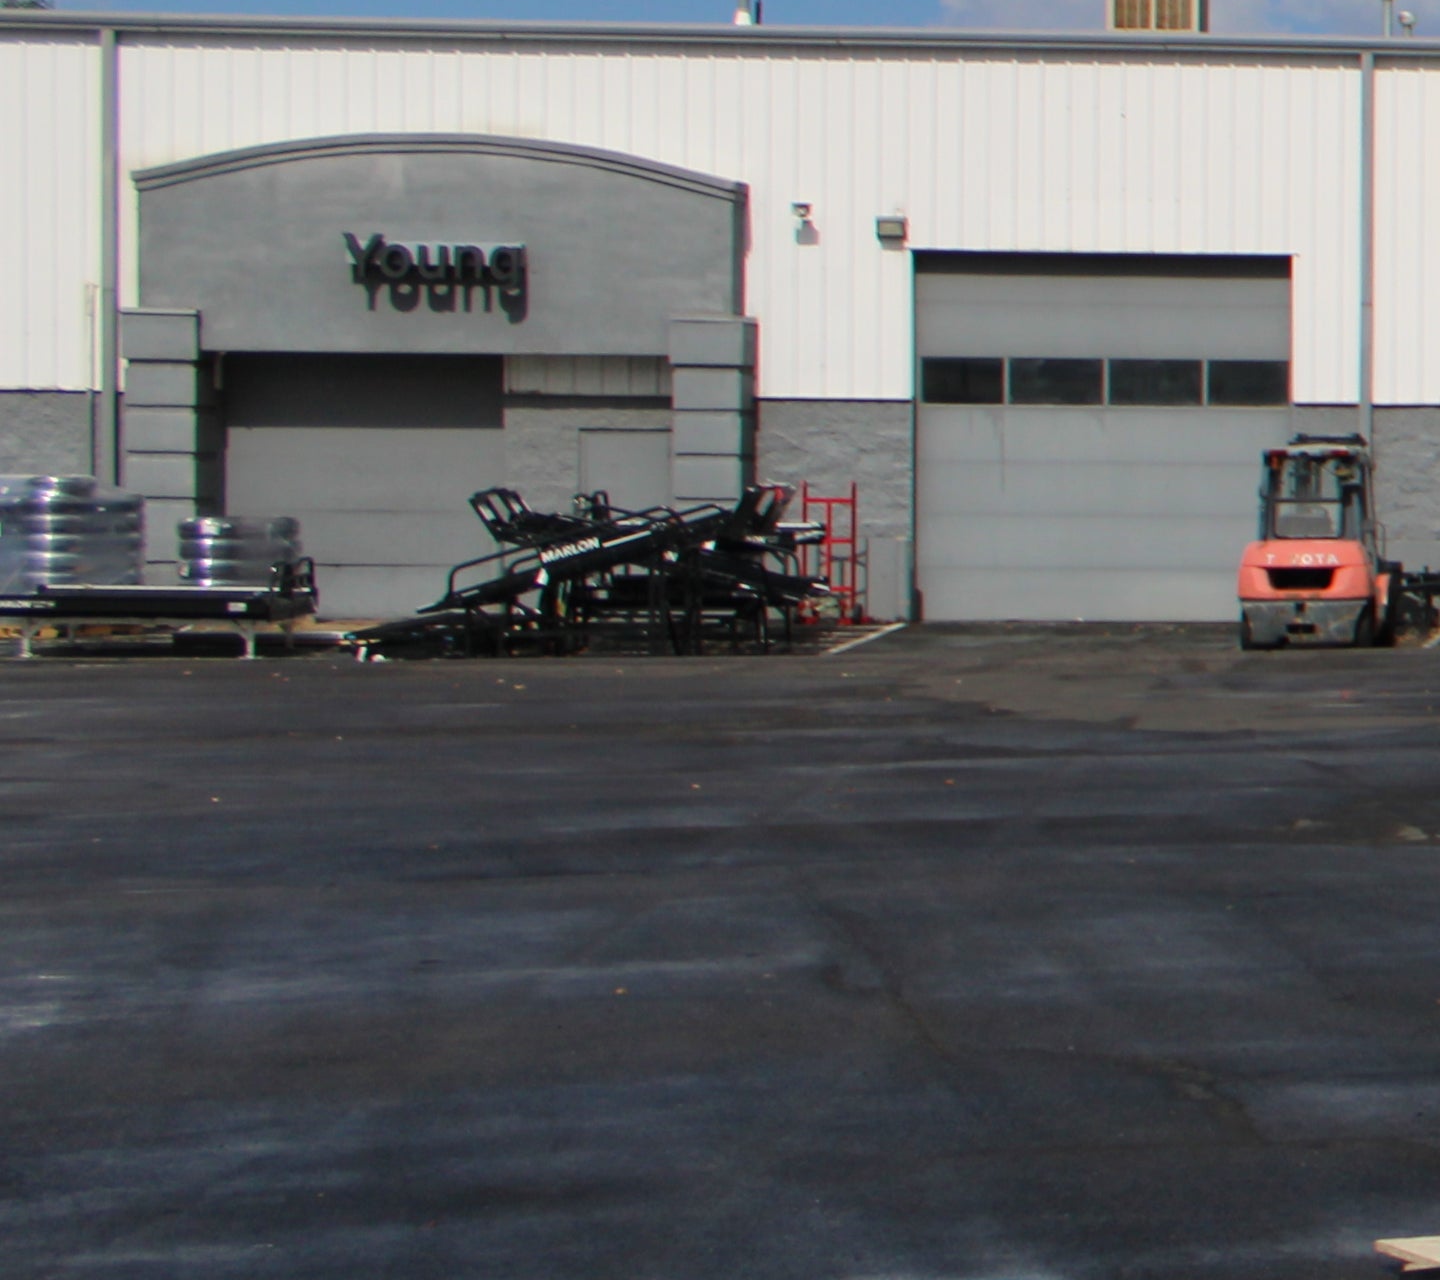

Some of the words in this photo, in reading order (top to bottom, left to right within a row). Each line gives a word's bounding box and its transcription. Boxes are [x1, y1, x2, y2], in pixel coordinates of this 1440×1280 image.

[342, 231, 526, 295] Young
[539, 536, 601, 564] MARLON
[1265, 553, 1339, 565] TOTA
